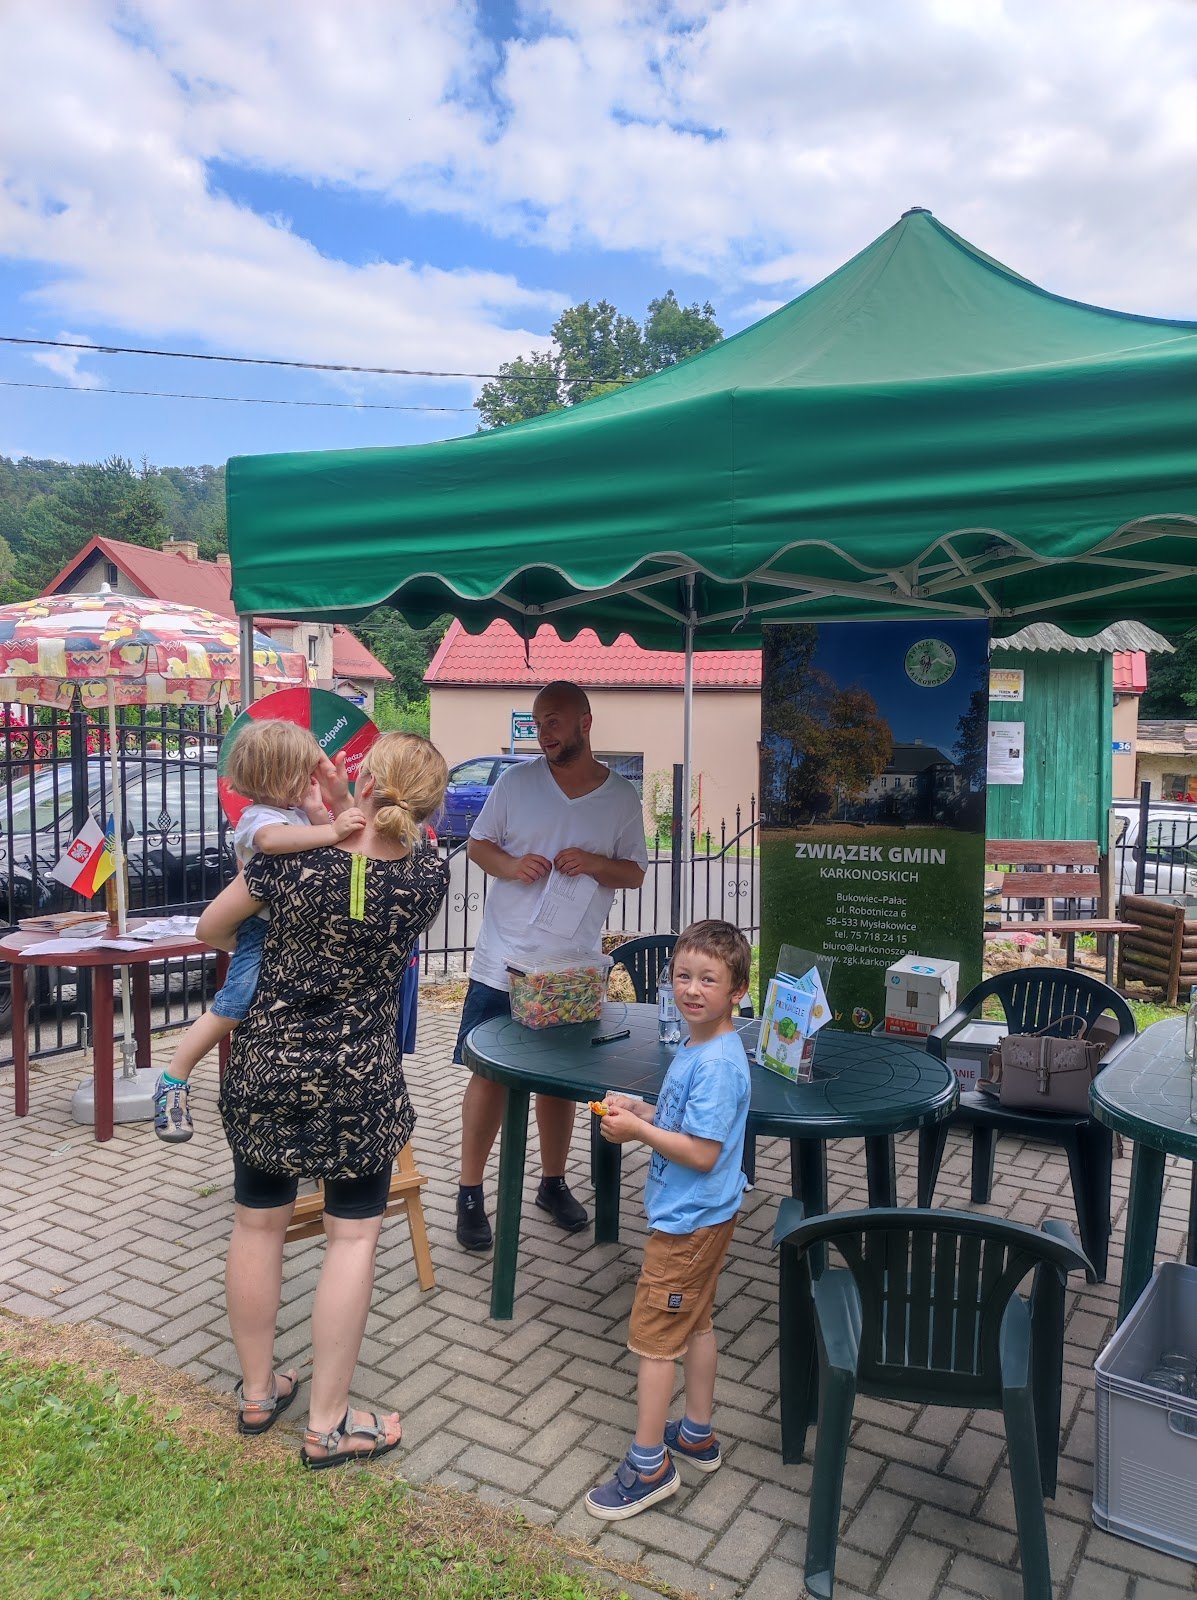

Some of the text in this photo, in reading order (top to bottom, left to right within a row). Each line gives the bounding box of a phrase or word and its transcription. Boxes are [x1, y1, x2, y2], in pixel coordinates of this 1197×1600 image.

[318, 715, 349, 748] Odpady
[1119, 742, 1131, 750] 36
[795, 843, 946, 865] ZWIĄZEK GMIN
[820, 867, 919, 883] KARKONOSKICH
[836, 906, 907, 918] ul. Robotnicza 6
[860, 919, 917, 931] Mysłakowice
[834, 930, 908, 943] tel. 75 718 24 15
